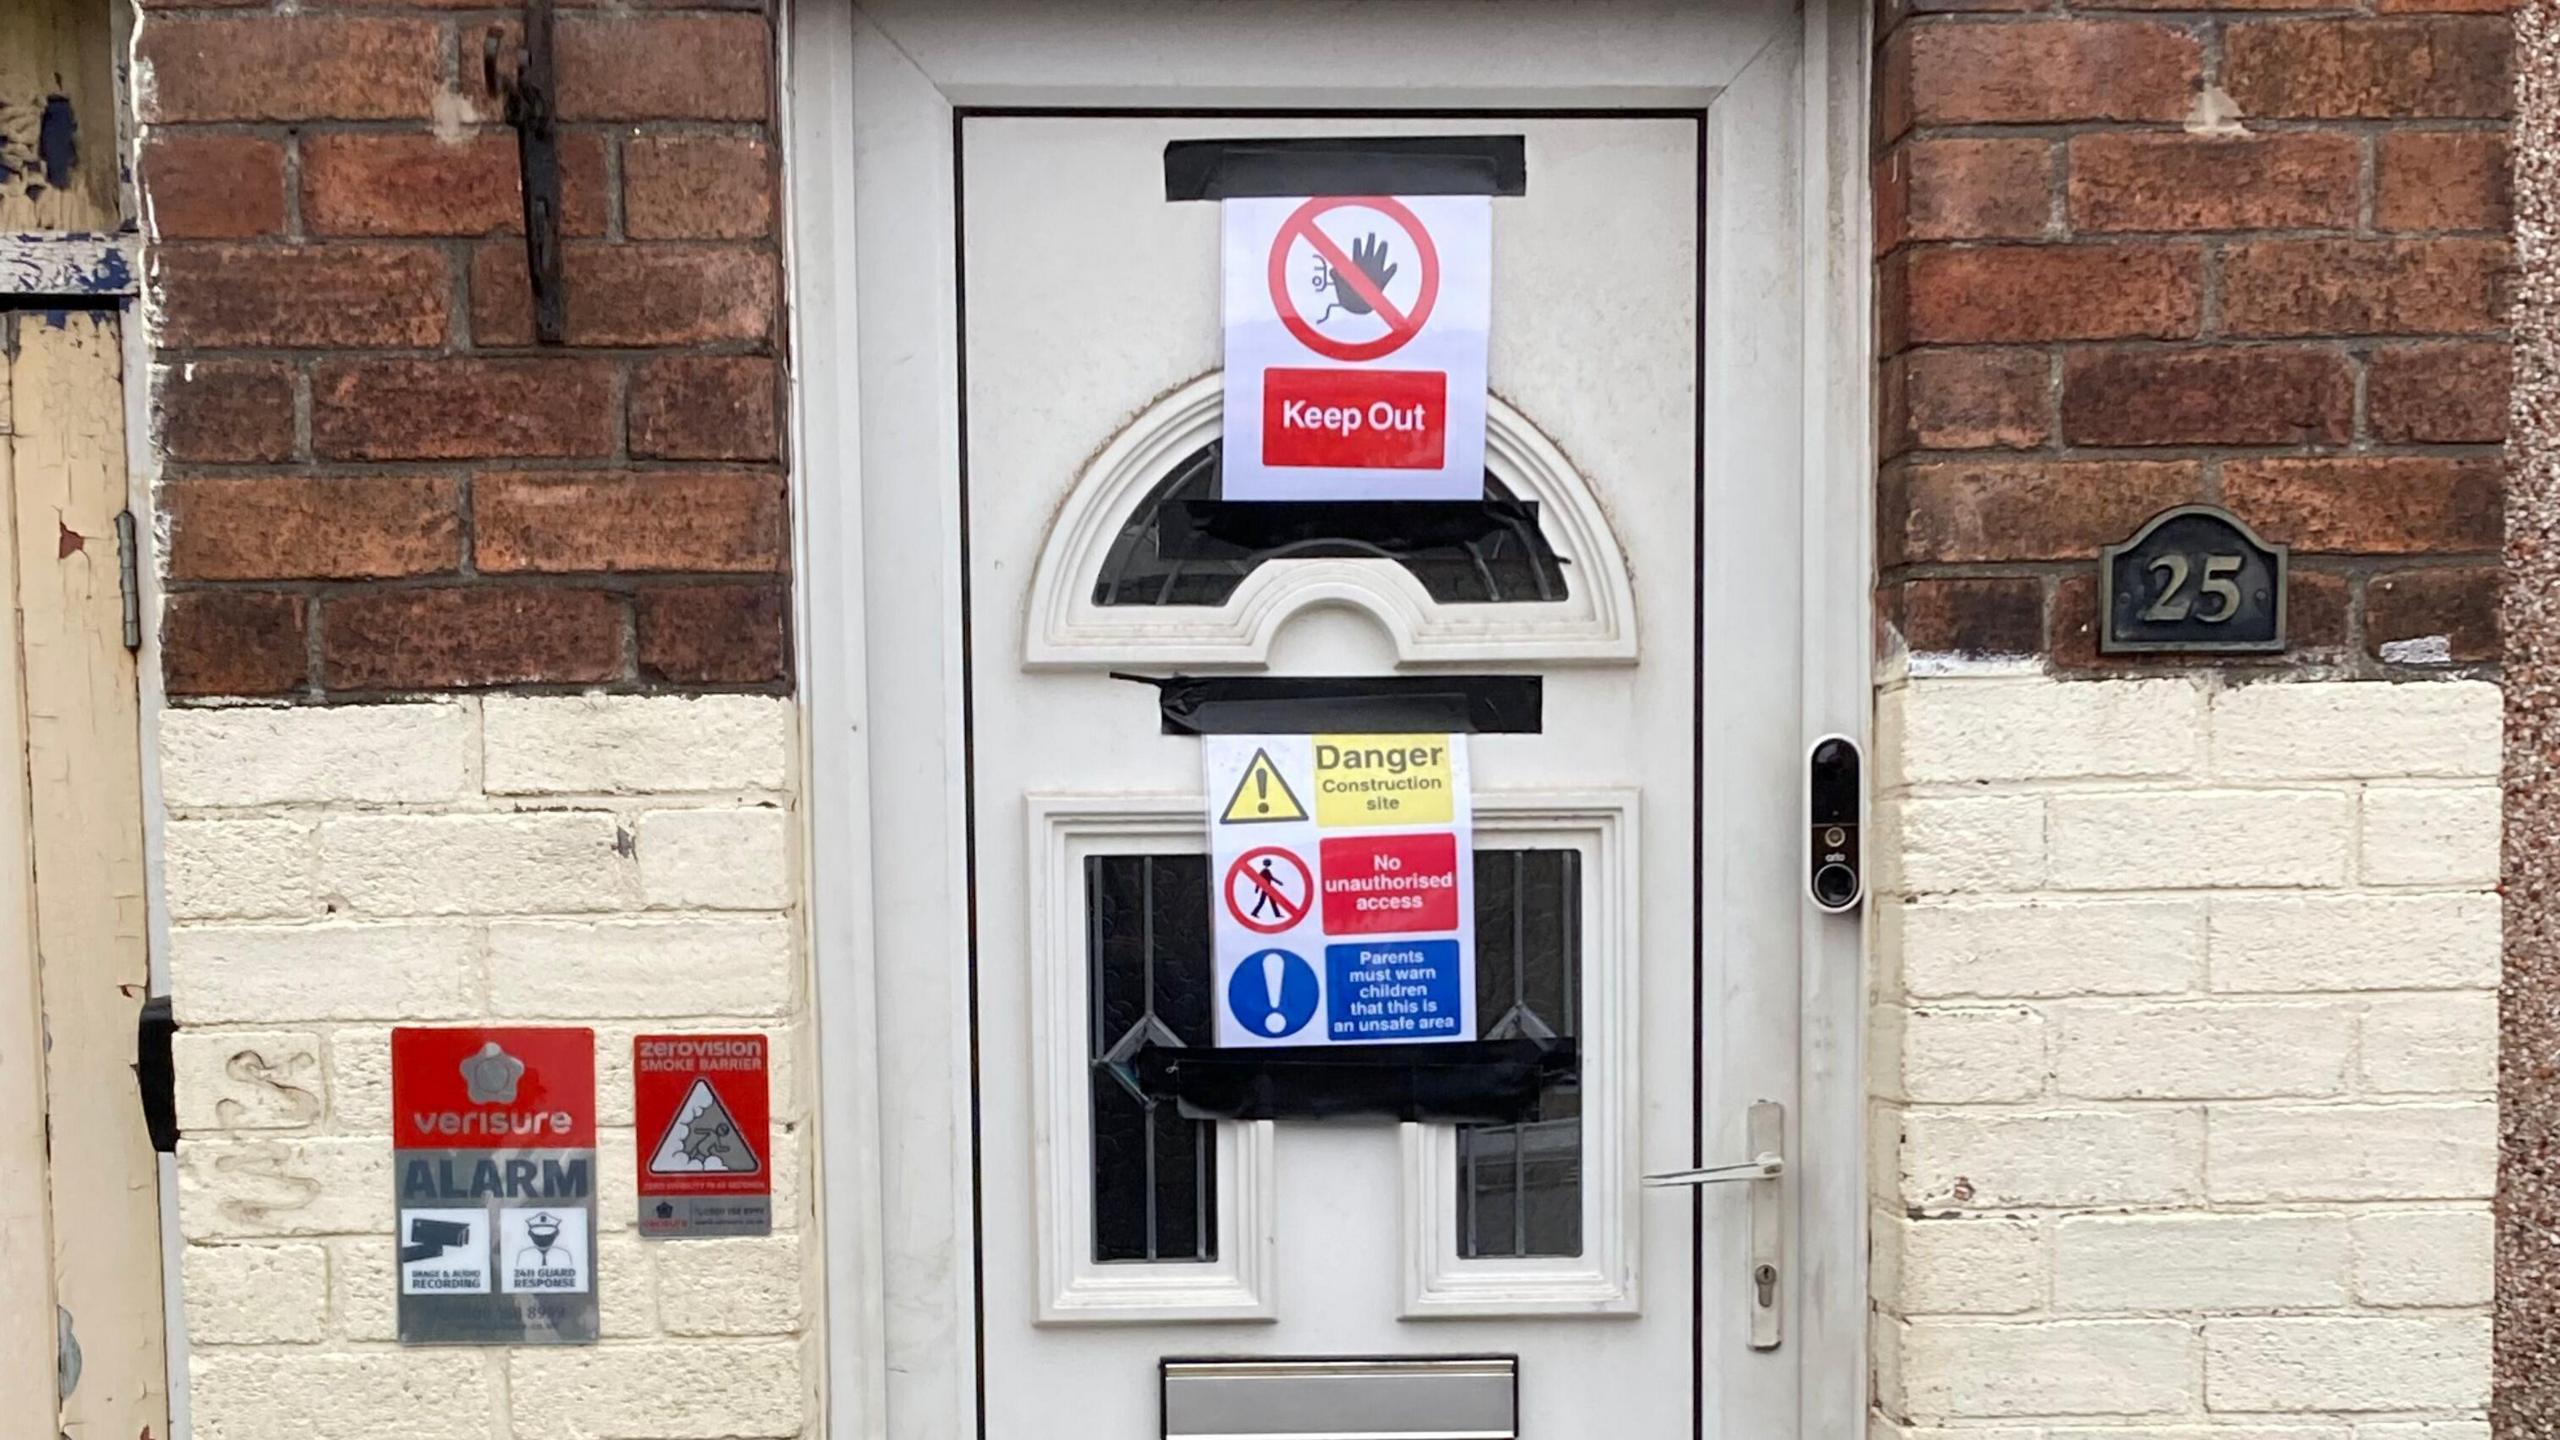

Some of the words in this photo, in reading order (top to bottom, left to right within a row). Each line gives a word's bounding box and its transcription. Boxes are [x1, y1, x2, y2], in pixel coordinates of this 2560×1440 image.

[1282, 400, 1362, 437] Keep
[1368, 401, 1426, 431] Out
[2143, 553, 2243, 623] 25
[1315, 744, 1444, 774] Danger
[1322, 776, 1442, 793] Construction
[1366, 796, 1400, 811] site
[1373, 854, 1402, 871] No
[1325, 872, 1453, 893] unauthorised
[1356, 895, 1424, 911] access
[1359, 950, 1425, 965] Parents
[1349, 968, 1392, 982] must
[1395, 967, 1437, 980] warn
[1359, 983, 1428, 999] children
[1350, 1001, 1383, 1016] that
[1387, 999, 1419, 1014] this
[1422, 998, 1438, 1012] is
[1333, 1020, 1355, 1033] an
[1358, 1016, 1415, 1032] unsafe
[1419, 1016, 1455, 1030] area
[640, 1041, 761, 1057] zerovision
[641, 1058, 695, 1072] SMOKE
[699, 1057, 761, 1071] BARRIER
[414, 1111, 573, 1135] verisure
[403, 1158, 589, 1198] ALARM
[513, 1269, 536, 1278] 24H
[537, 1268, 576, 1278] GUARD
[412, 1278, 481, 1289] RECORDING
[513, 1278, 576, 1288] RESPONSE
